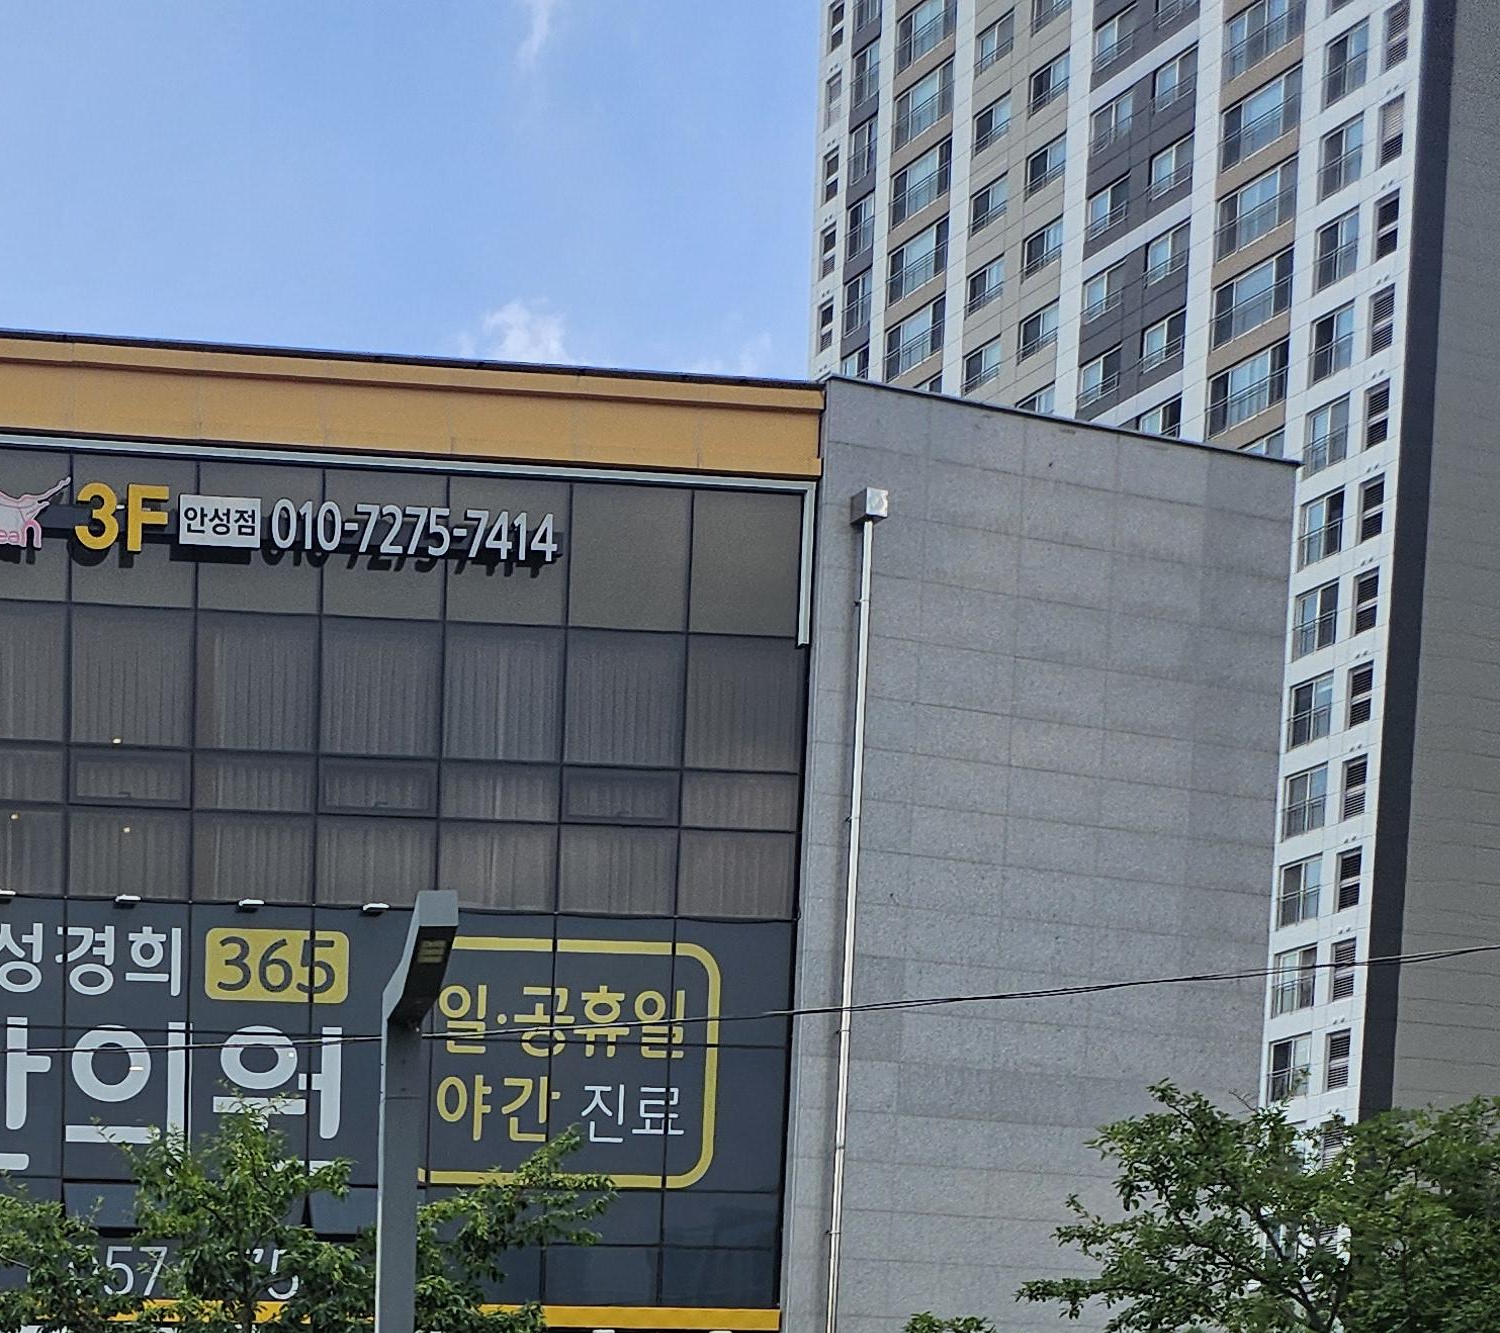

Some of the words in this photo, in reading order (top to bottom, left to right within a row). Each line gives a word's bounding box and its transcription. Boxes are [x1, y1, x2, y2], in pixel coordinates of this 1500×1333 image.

[75, 482, 171, 553] 3F
[183, 504, 257, 546] 안성점
[271, 500, 558, 562] 010-7275-7414
[217, 936, 334, 994] 365
[437, 1073, 562, 1143] 야간
[580, 1083, 686, 1144] 진료
